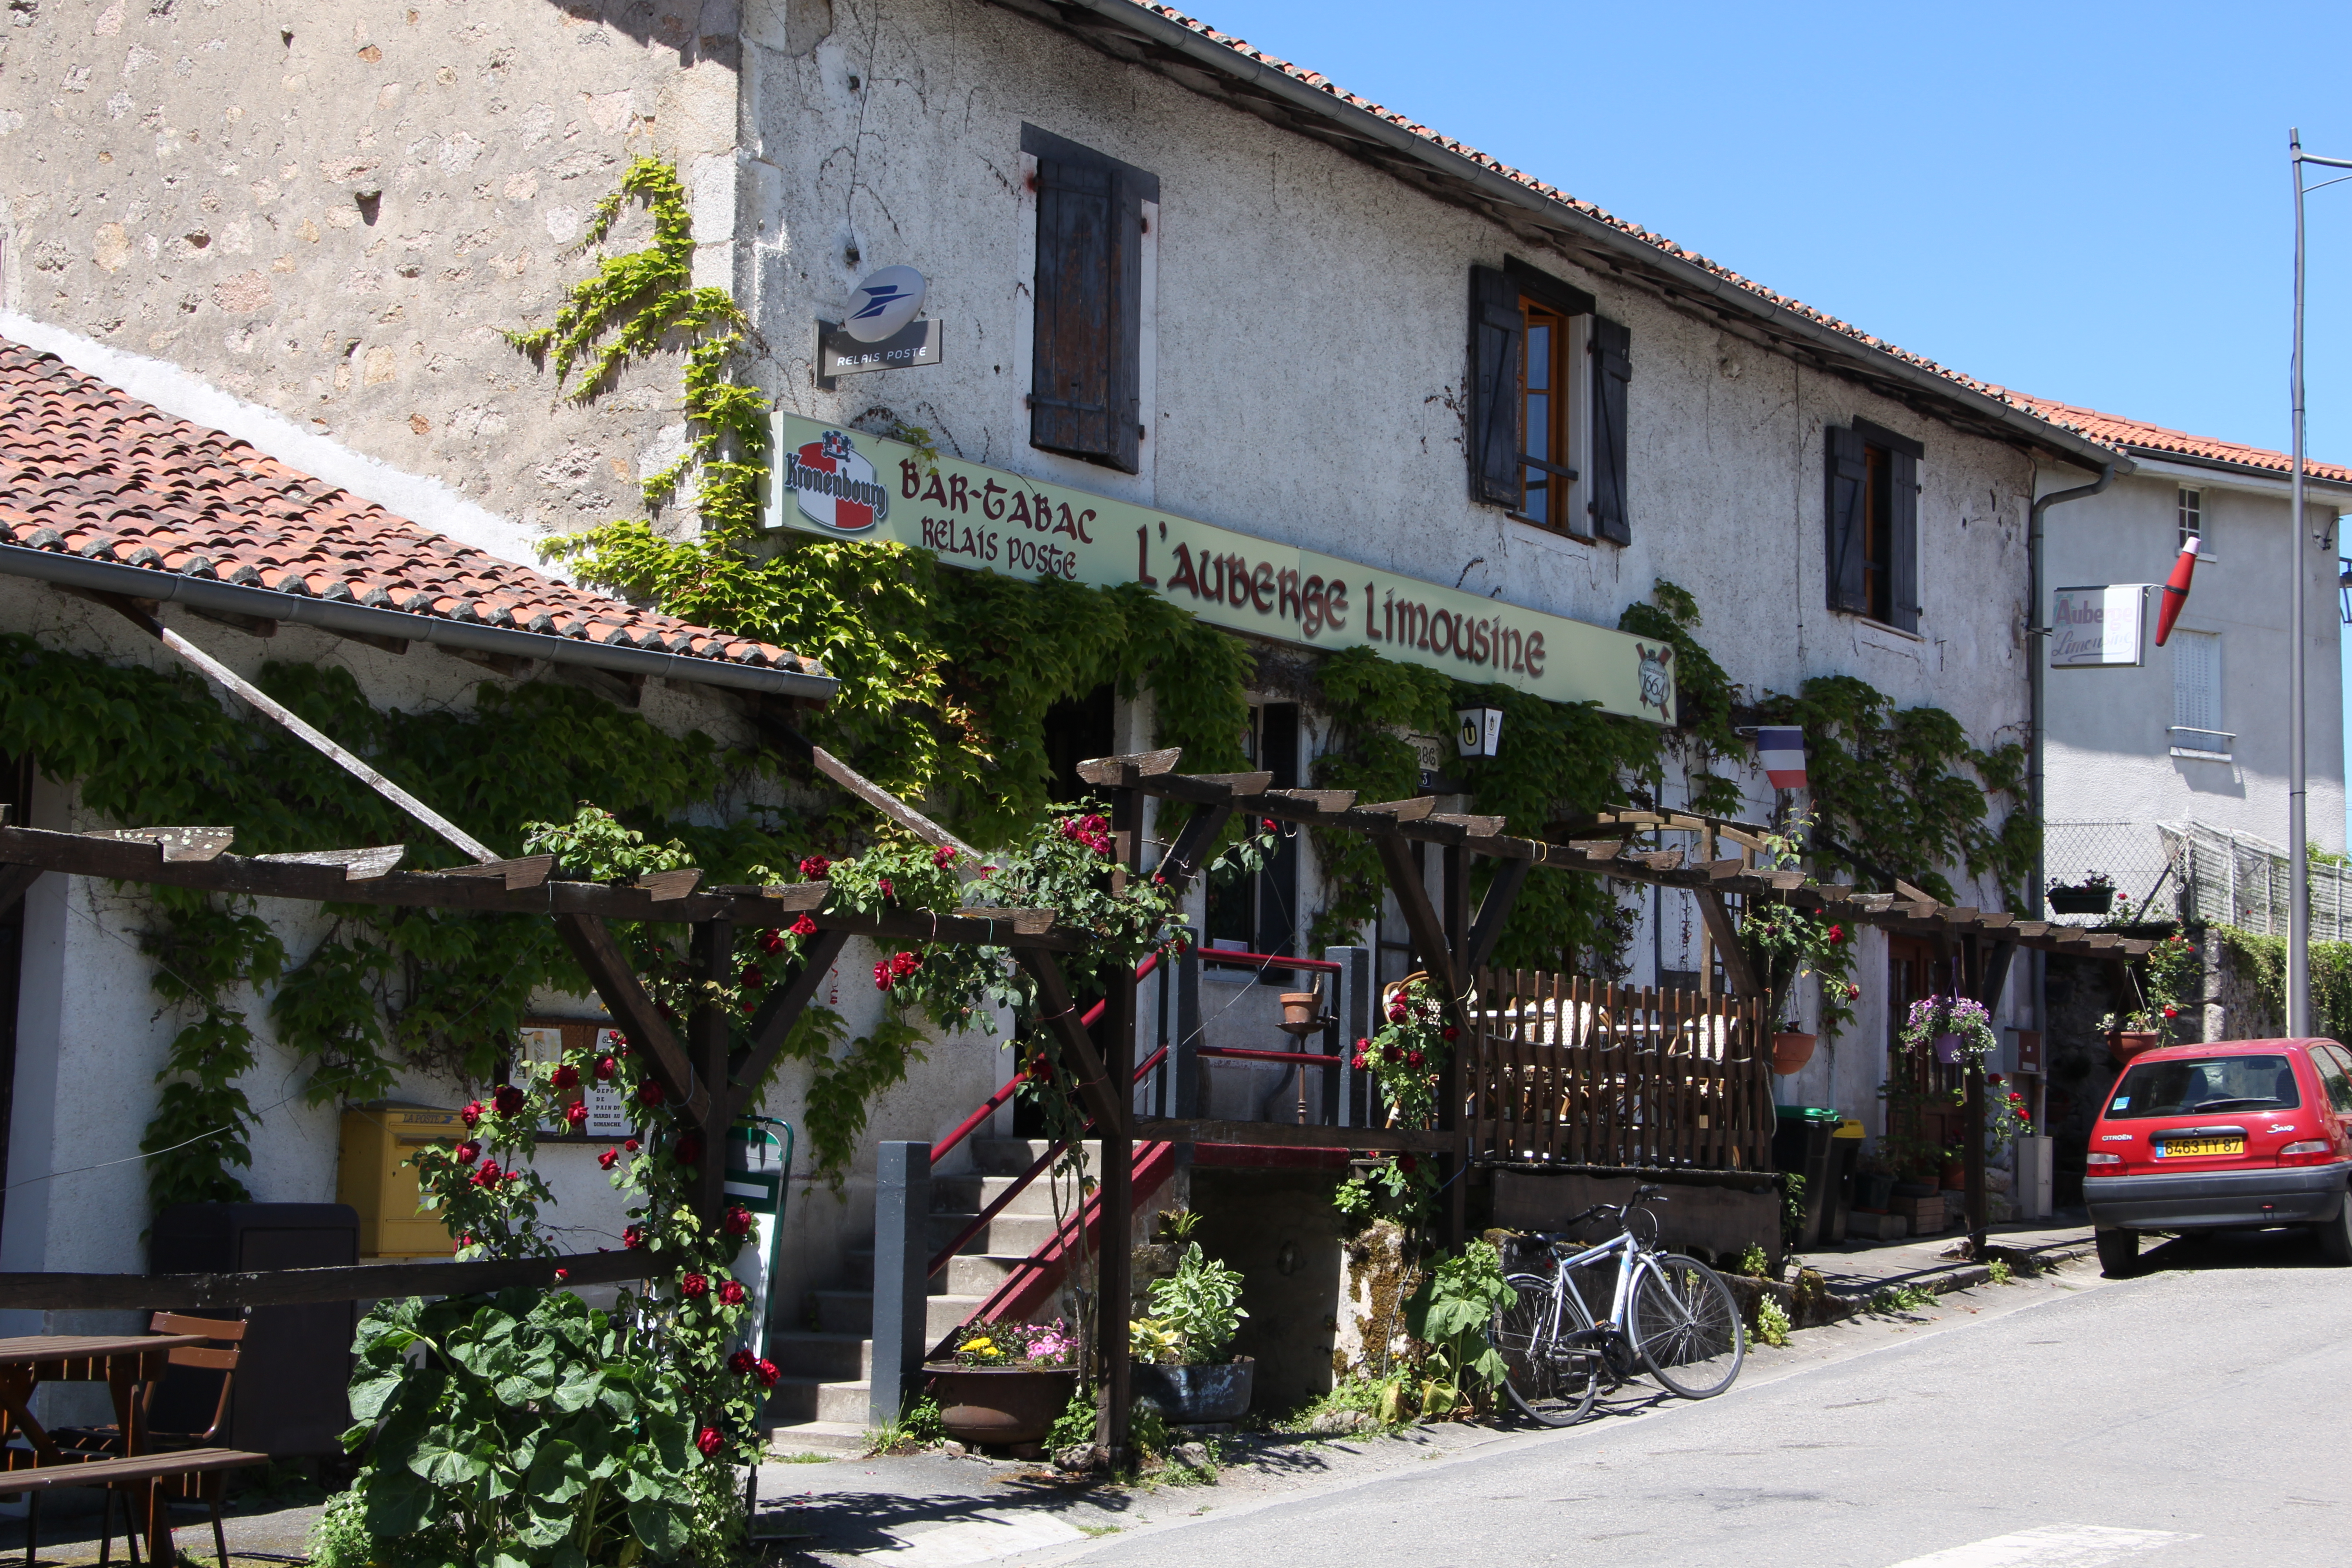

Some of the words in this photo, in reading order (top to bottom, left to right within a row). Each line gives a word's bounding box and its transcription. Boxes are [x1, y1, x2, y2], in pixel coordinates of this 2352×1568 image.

[837, 353, 880, 366] RELAIS
[887, 346, 927, 360] POSTE
[784, 452, 886, 518] Kronenbourg
[898, 458, 1097, 544] BAR-TABAC
[921, 516, 998, 561] RELAIS
[1006, 536, 1077, 580] POSTE
[2055, 598, 2133, 631] Auberge
[1364, 581, 1545, 675] Limousine
[1642, 674, 1665, 701] 1664
[1415, 745, 1436, 765] 886
[1422, 772, 1428, 785] 3
[402, 1113, 413, 1122] LA
[415, 1114, 440, 1123] POSTE
[2102, 1133, 2132, 1142] CITROËN
[2266, 1124, 2295, 1134] Saxo
[2165, 1139, 2200, 1155] 6463
[2202, 1139, 2219, 1153] TY
[2223, 1138, 2240, 1152] 87
